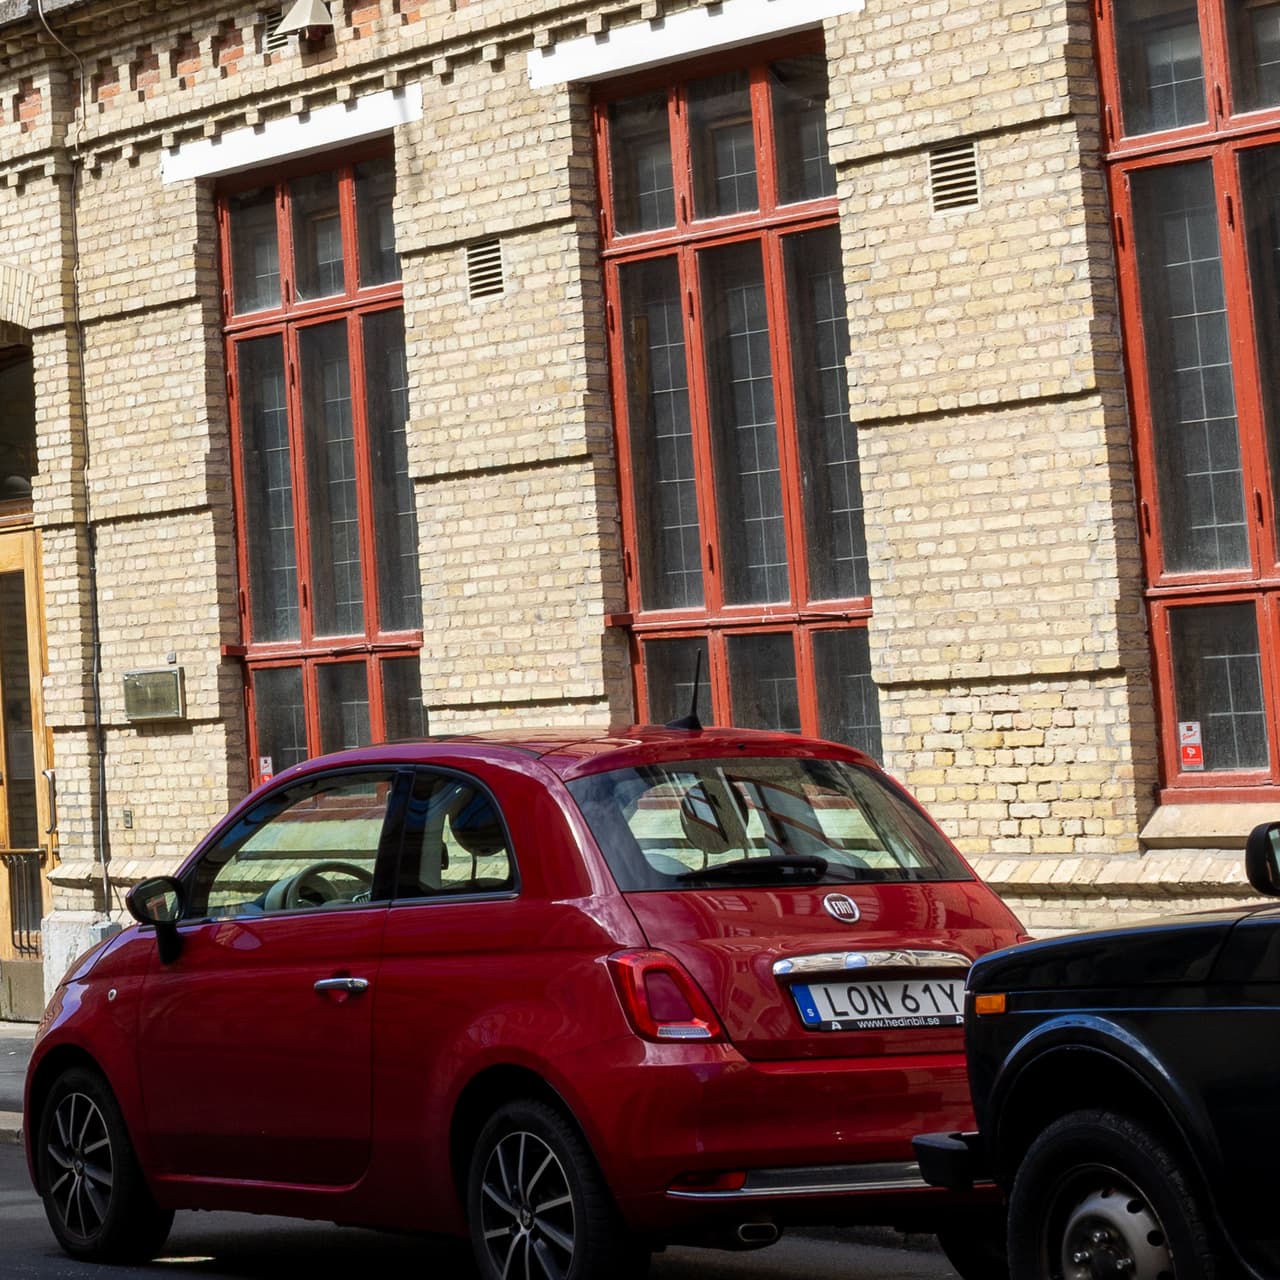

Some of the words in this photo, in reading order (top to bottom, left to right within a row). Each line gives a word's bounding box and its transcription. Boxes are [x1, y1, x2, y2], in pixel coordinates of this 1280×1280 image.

[832, 901, 853, 914] FIAT
[824, 984, 893, 1017] LON
[901, 983, 960, 1013] 61Y
[807, 1008, 815, 1017] S
[857, 1016, 940, 1029] www.hedinbil.se
